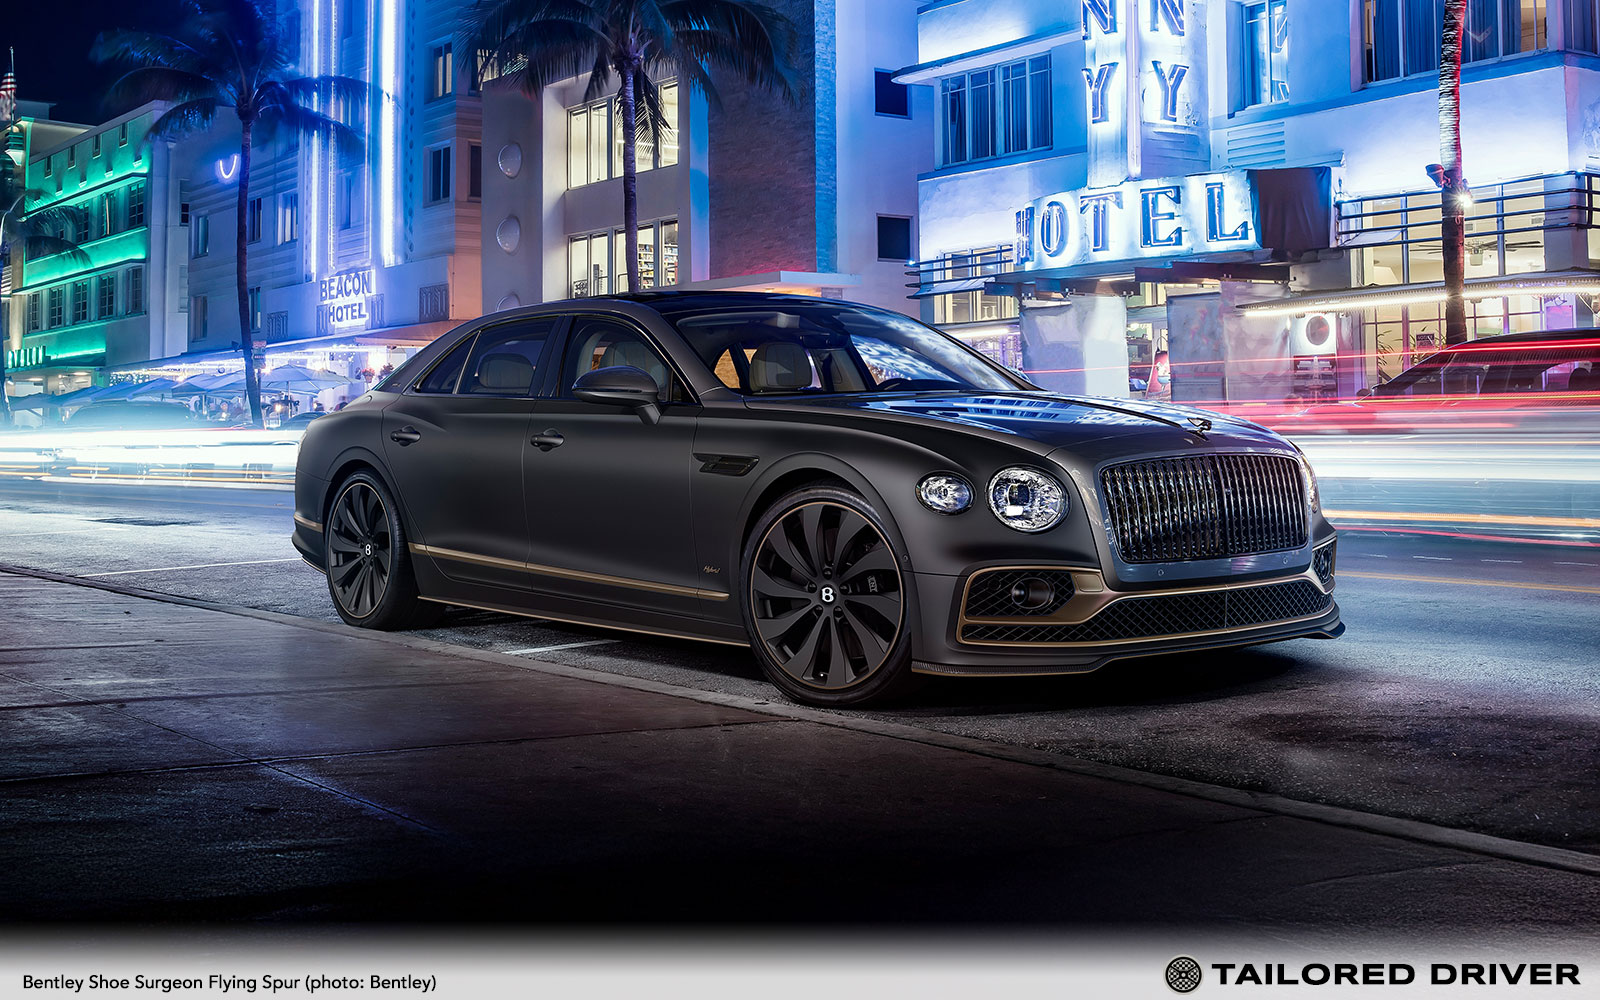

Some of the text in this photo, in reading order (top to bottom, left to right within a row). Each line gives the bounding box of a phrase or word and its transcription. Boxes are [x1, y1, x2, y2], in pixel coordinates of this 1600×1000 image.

[1015, 182, 1249, 266] HOTEL
[320, 271, 371, 301] BEACON
[328, 302, 367, 323] HOTEL
